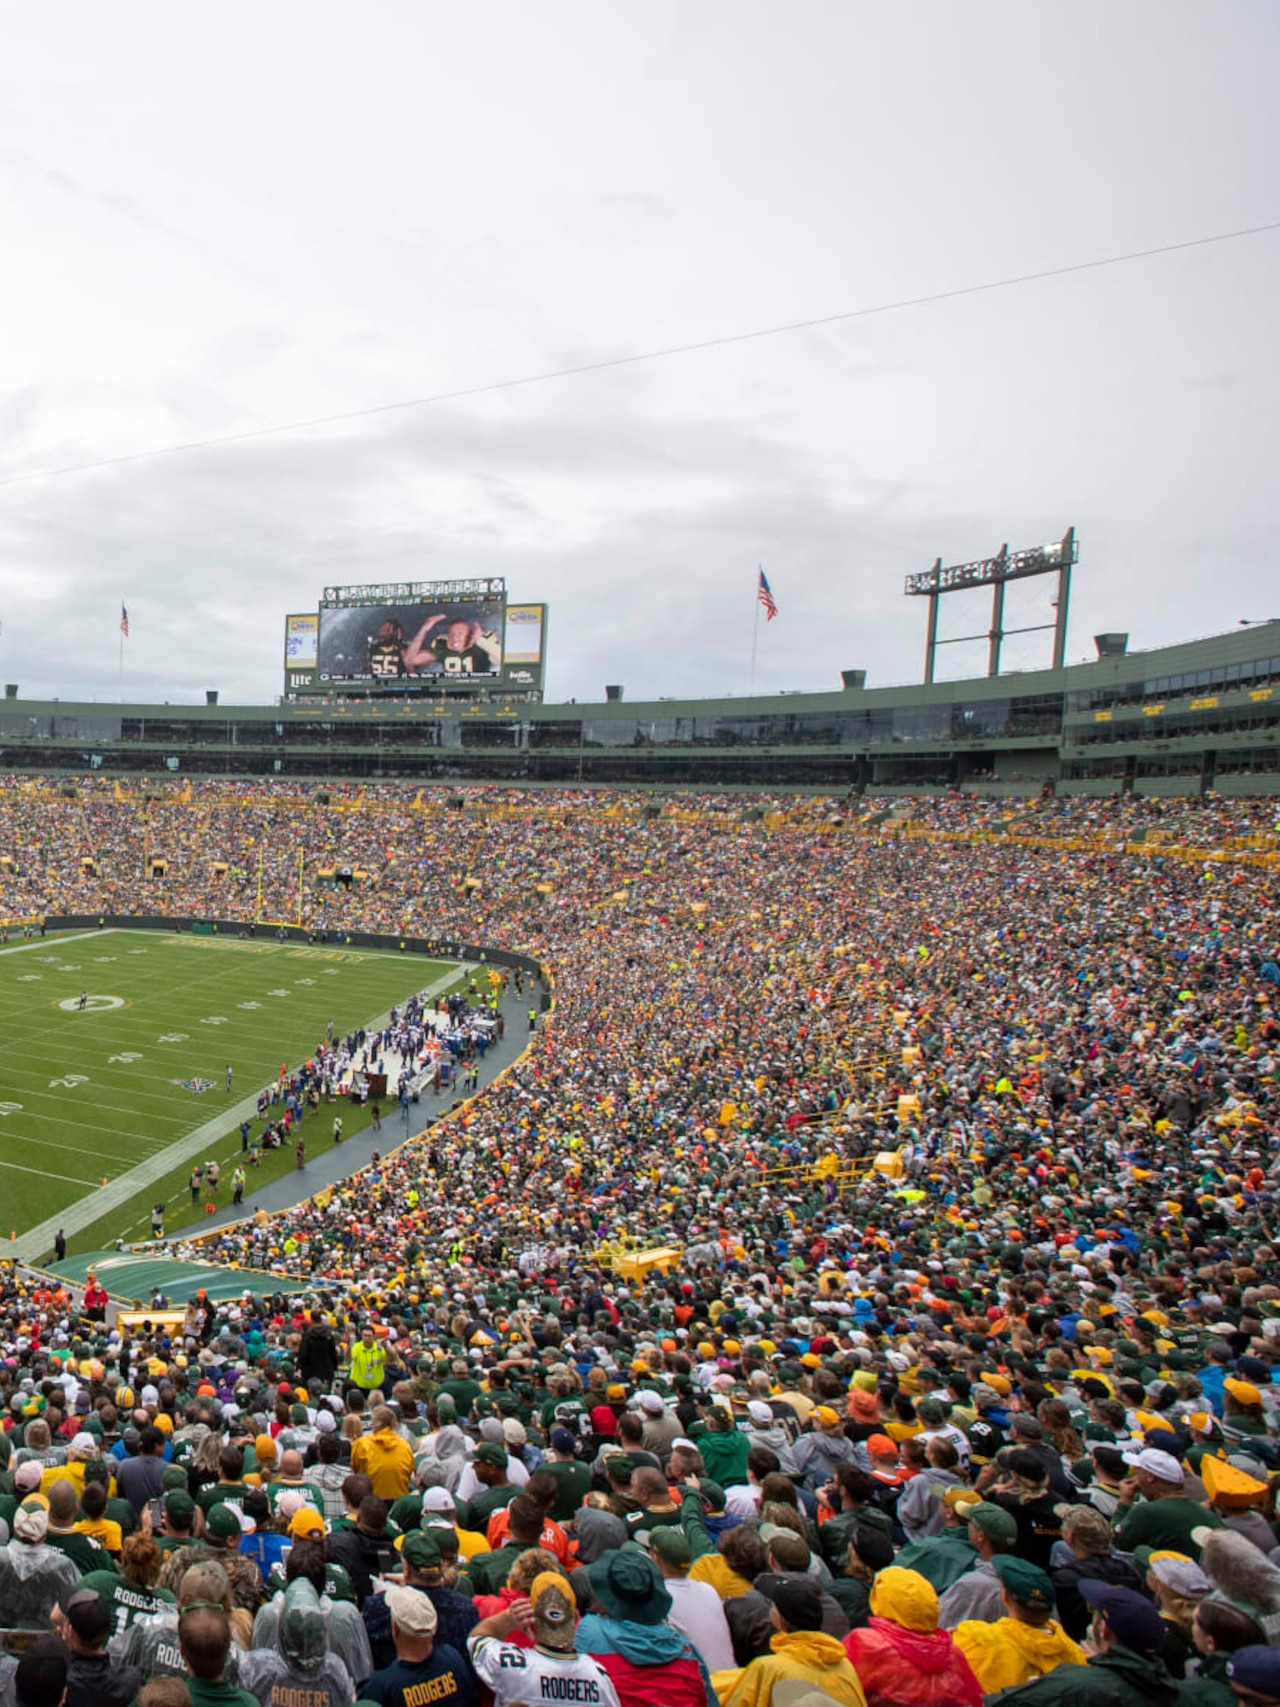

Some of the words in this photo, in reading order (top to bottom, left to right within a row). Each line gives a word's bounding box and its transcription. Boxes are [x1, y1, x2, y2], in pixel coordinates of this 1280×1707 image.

[291, 673, 312, 688] Lite
[48, 1074, 90, 1088] 20
[114, 1586, 165, 1614] RODGERS
[271, 1684, 331, 1707] RODGERS
[402, 1671, 458, 1707] RODGERS
[540, 1676, 600, 1704] RODGERS
